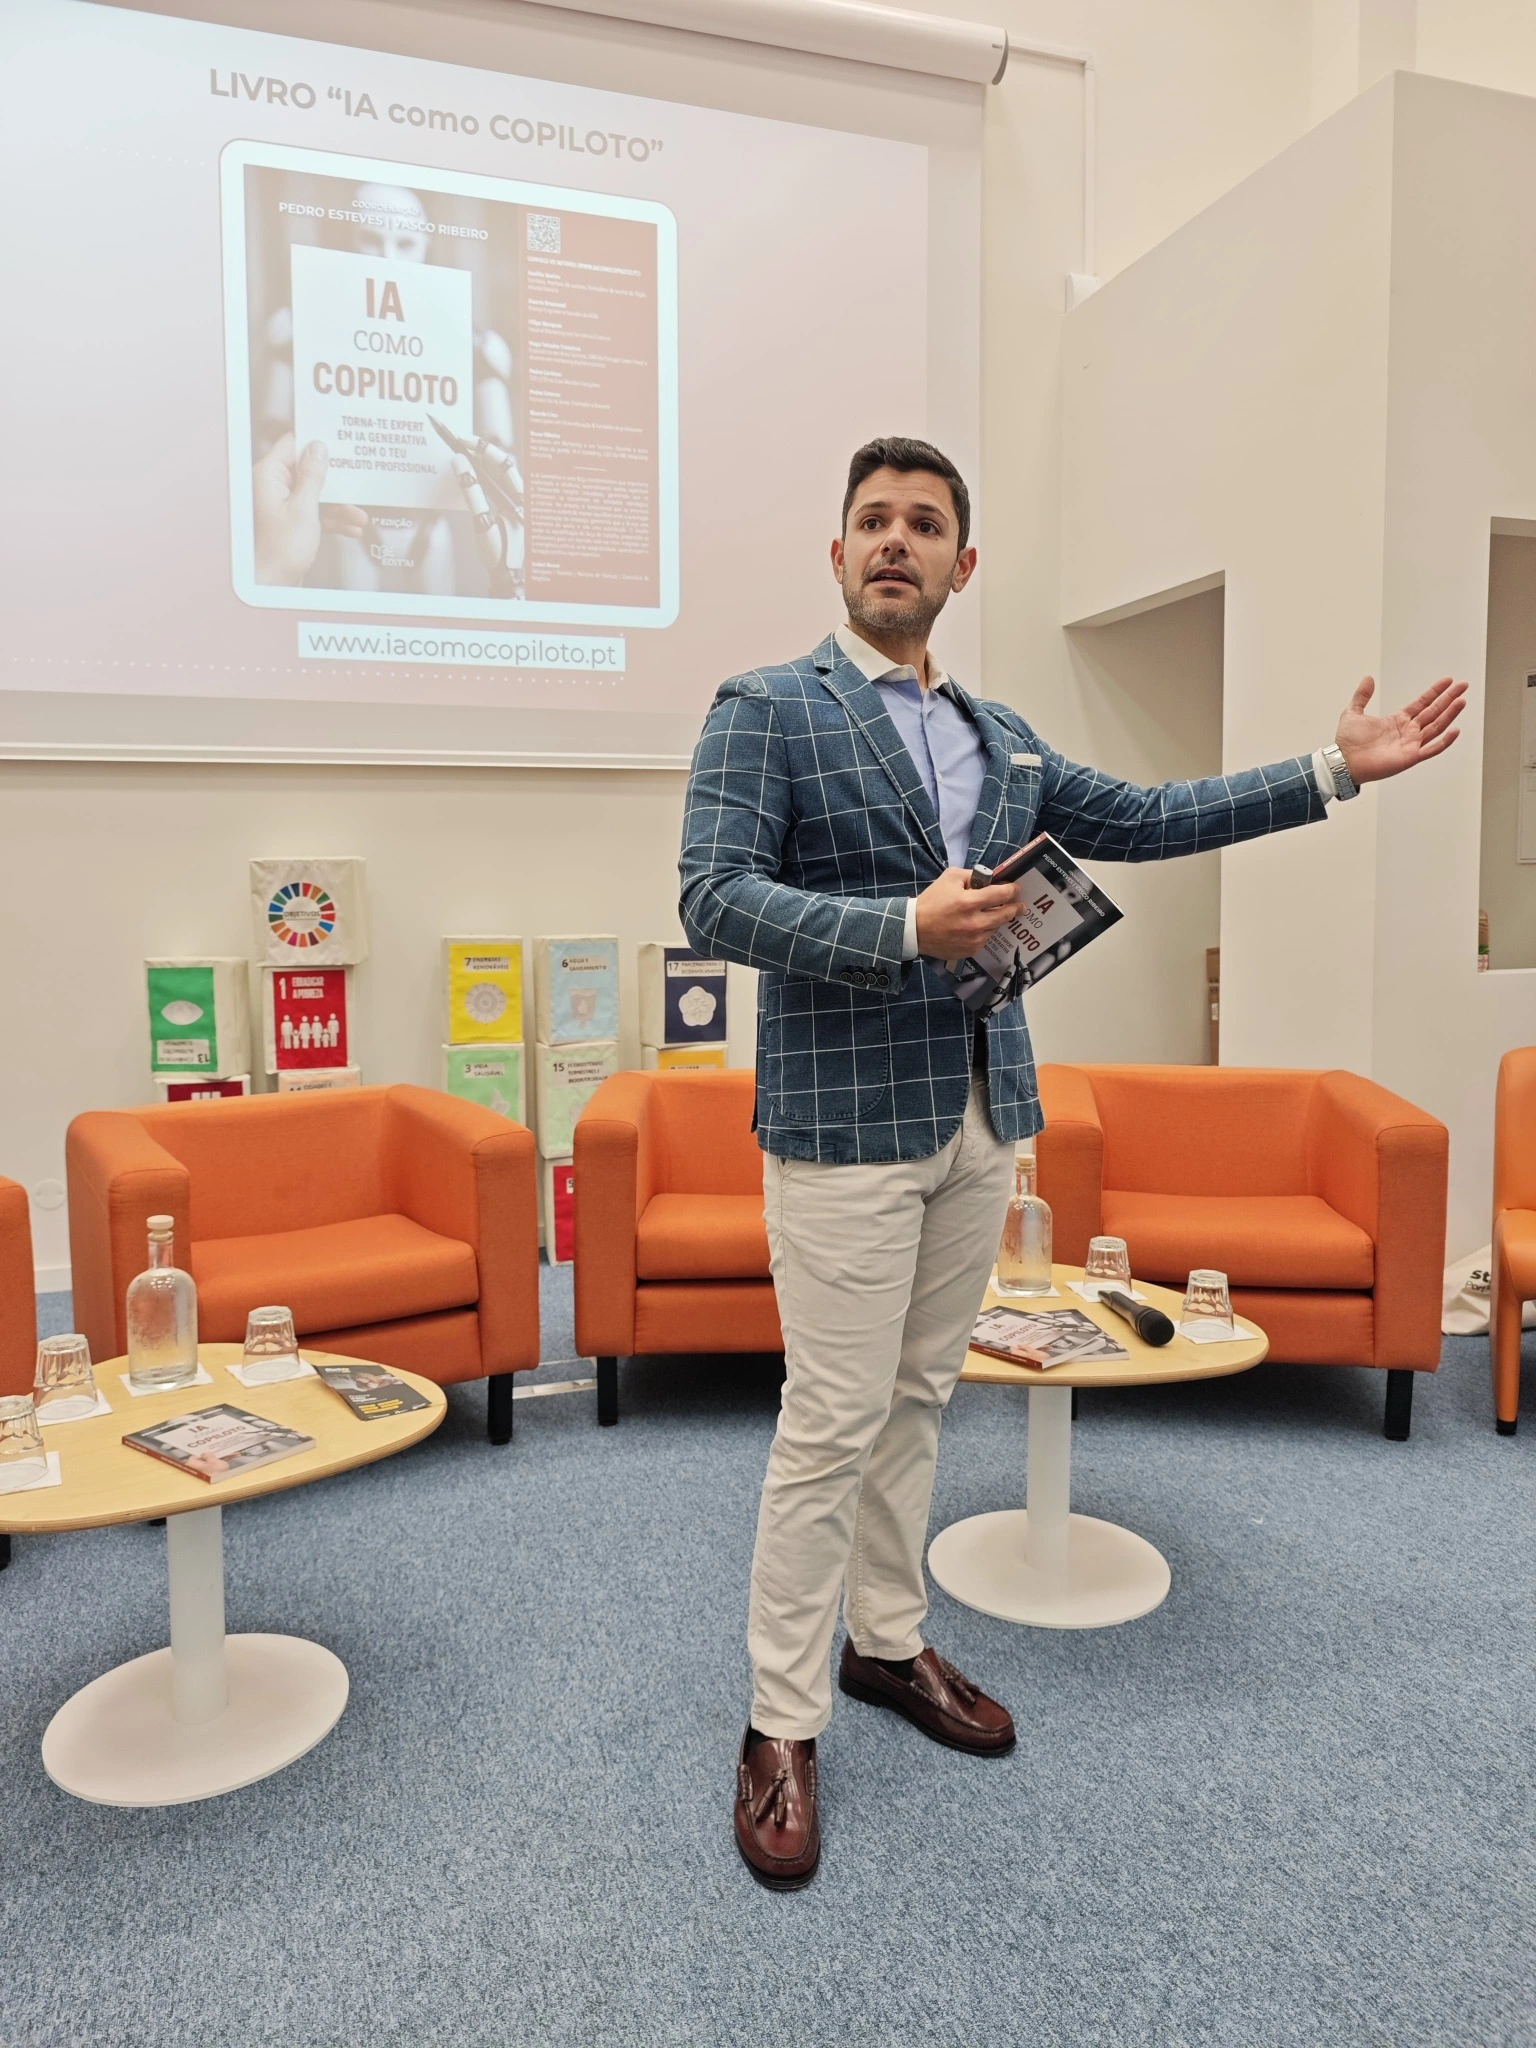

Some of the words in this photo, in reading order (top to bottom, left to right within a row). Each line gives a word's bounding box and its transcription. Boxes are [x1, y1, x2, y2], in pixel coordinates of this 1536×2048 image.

[210, 68, 317, 110] LIVRO
[388, 103, 479, 135] como
[279, 202, 325, 218] PEDRO
[328, 209, 384, 226] ESTEVES
[392, 217, 436, 233] VASCO
[438, 224, 489, 241] RIBEIRO
[365, 277, 406, 322] IA
[353, 330, 424, 358] COMO
[313, 361, 458, 407] COPILOTO
[341, 415, 388, 429] TORNA-TE
[390, 419, 424, 432] EXPERT
[337, 430, 353, 441] EM
[355, 431, 366, 442] IA
[367, 432, 428, 447] GENERATIVA
[354, 445, 377, 457] COM
[379, 446, 386, 458] O
[389, 447, 407, 459] TEU
[329, 457, 373, 470] COPILOTO
[375, 460, 438, 474] PROFISSIONAL
[308, 631, 617, 670] www.iacomocopiloto.pt
[1042, 854, 1058, 868] PEDRO
[1056, 866, 1074, 885] ESTEVES
[1075, 885, 1090, 900] VASCO
[1088, 898, 1106, 917] RIBEIRO
[1033, 893, 1055, 915] IA
[1023, 908, 1043, 929] OMO
[1008, 916, 1041, 952] ILOTO
[991, 935, 1010, 954] ENERATIVA
[464, 957, 472, 966] 7
[561, 959, 569, 968] 6
[668, 962, 679, 971] 17
[279, 977, 287, 1000] 1
[465, 1063, 472, 1073] 3
[553, 1062, 565, 1072] 15
[989, 1323, 1005, 1331] IA
[187, 1425, 247, 1448] COPILOTO
[188, 1425, 210, 1433] IA
